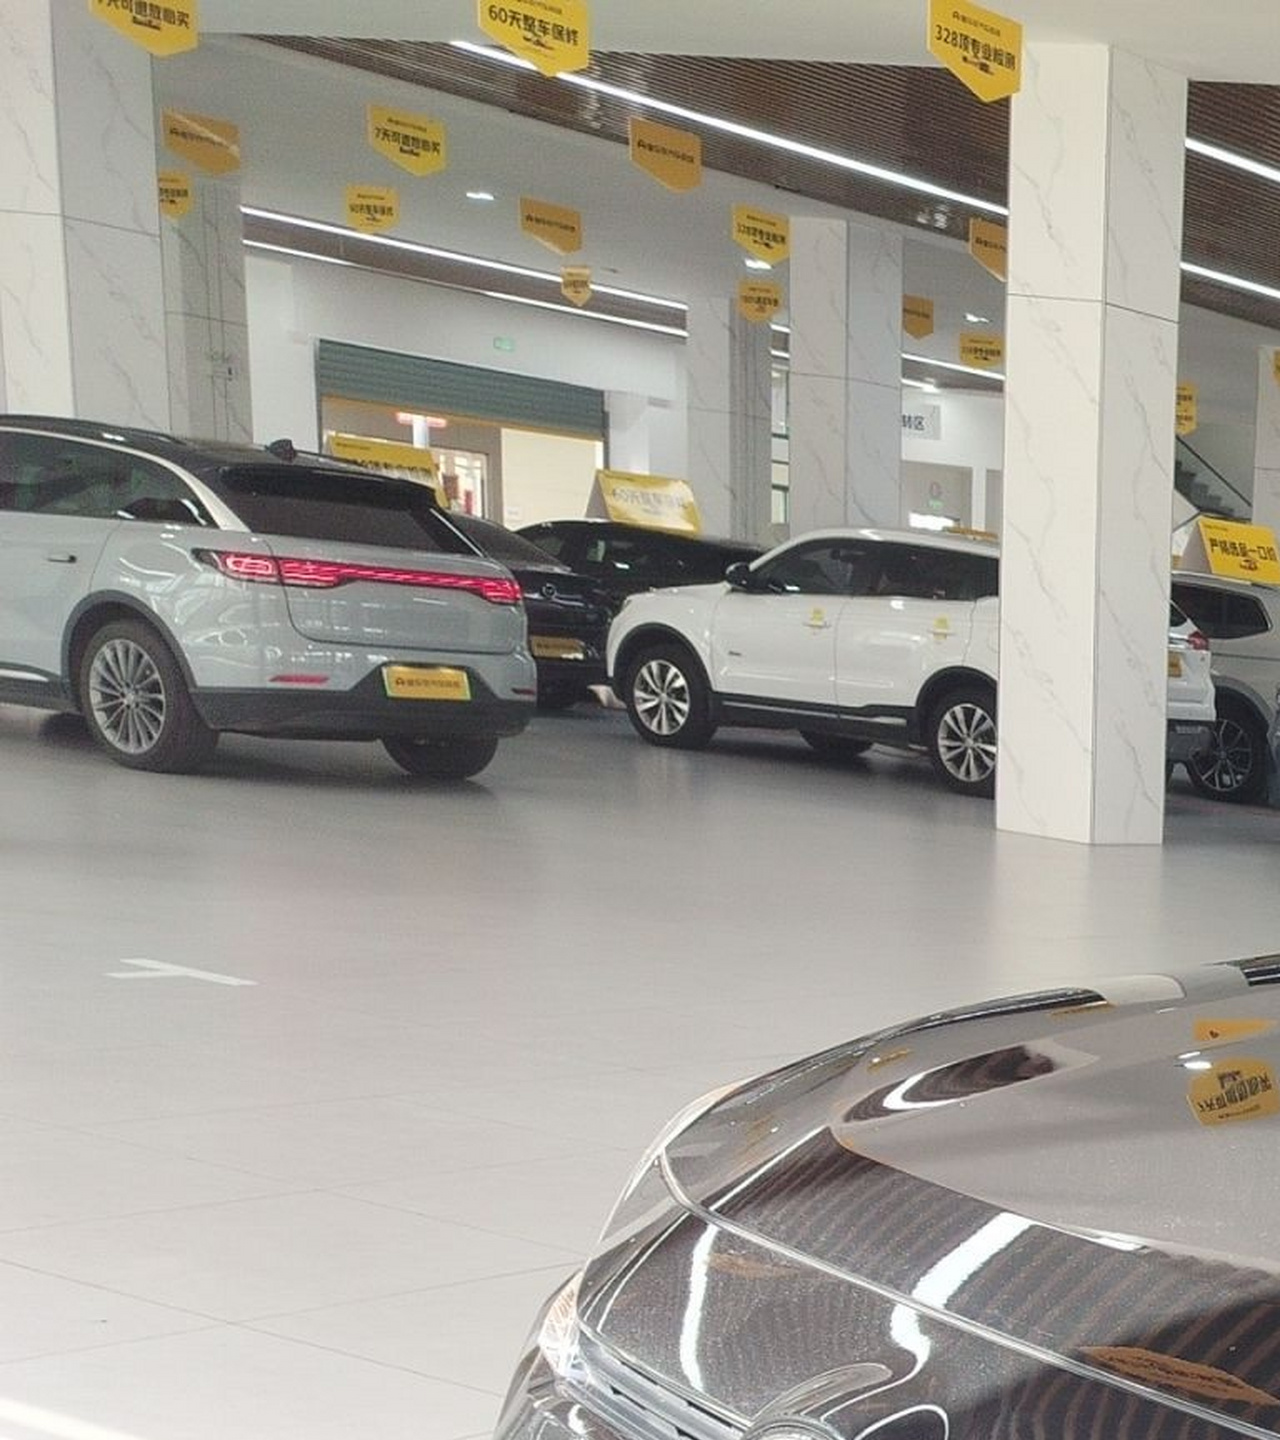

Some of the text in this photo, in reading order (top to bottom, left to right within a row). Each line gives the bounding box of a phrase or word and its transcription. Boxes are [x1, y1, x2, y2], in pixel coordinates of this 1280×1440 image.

[935, 24, 1017, 71] 328项专业检测
